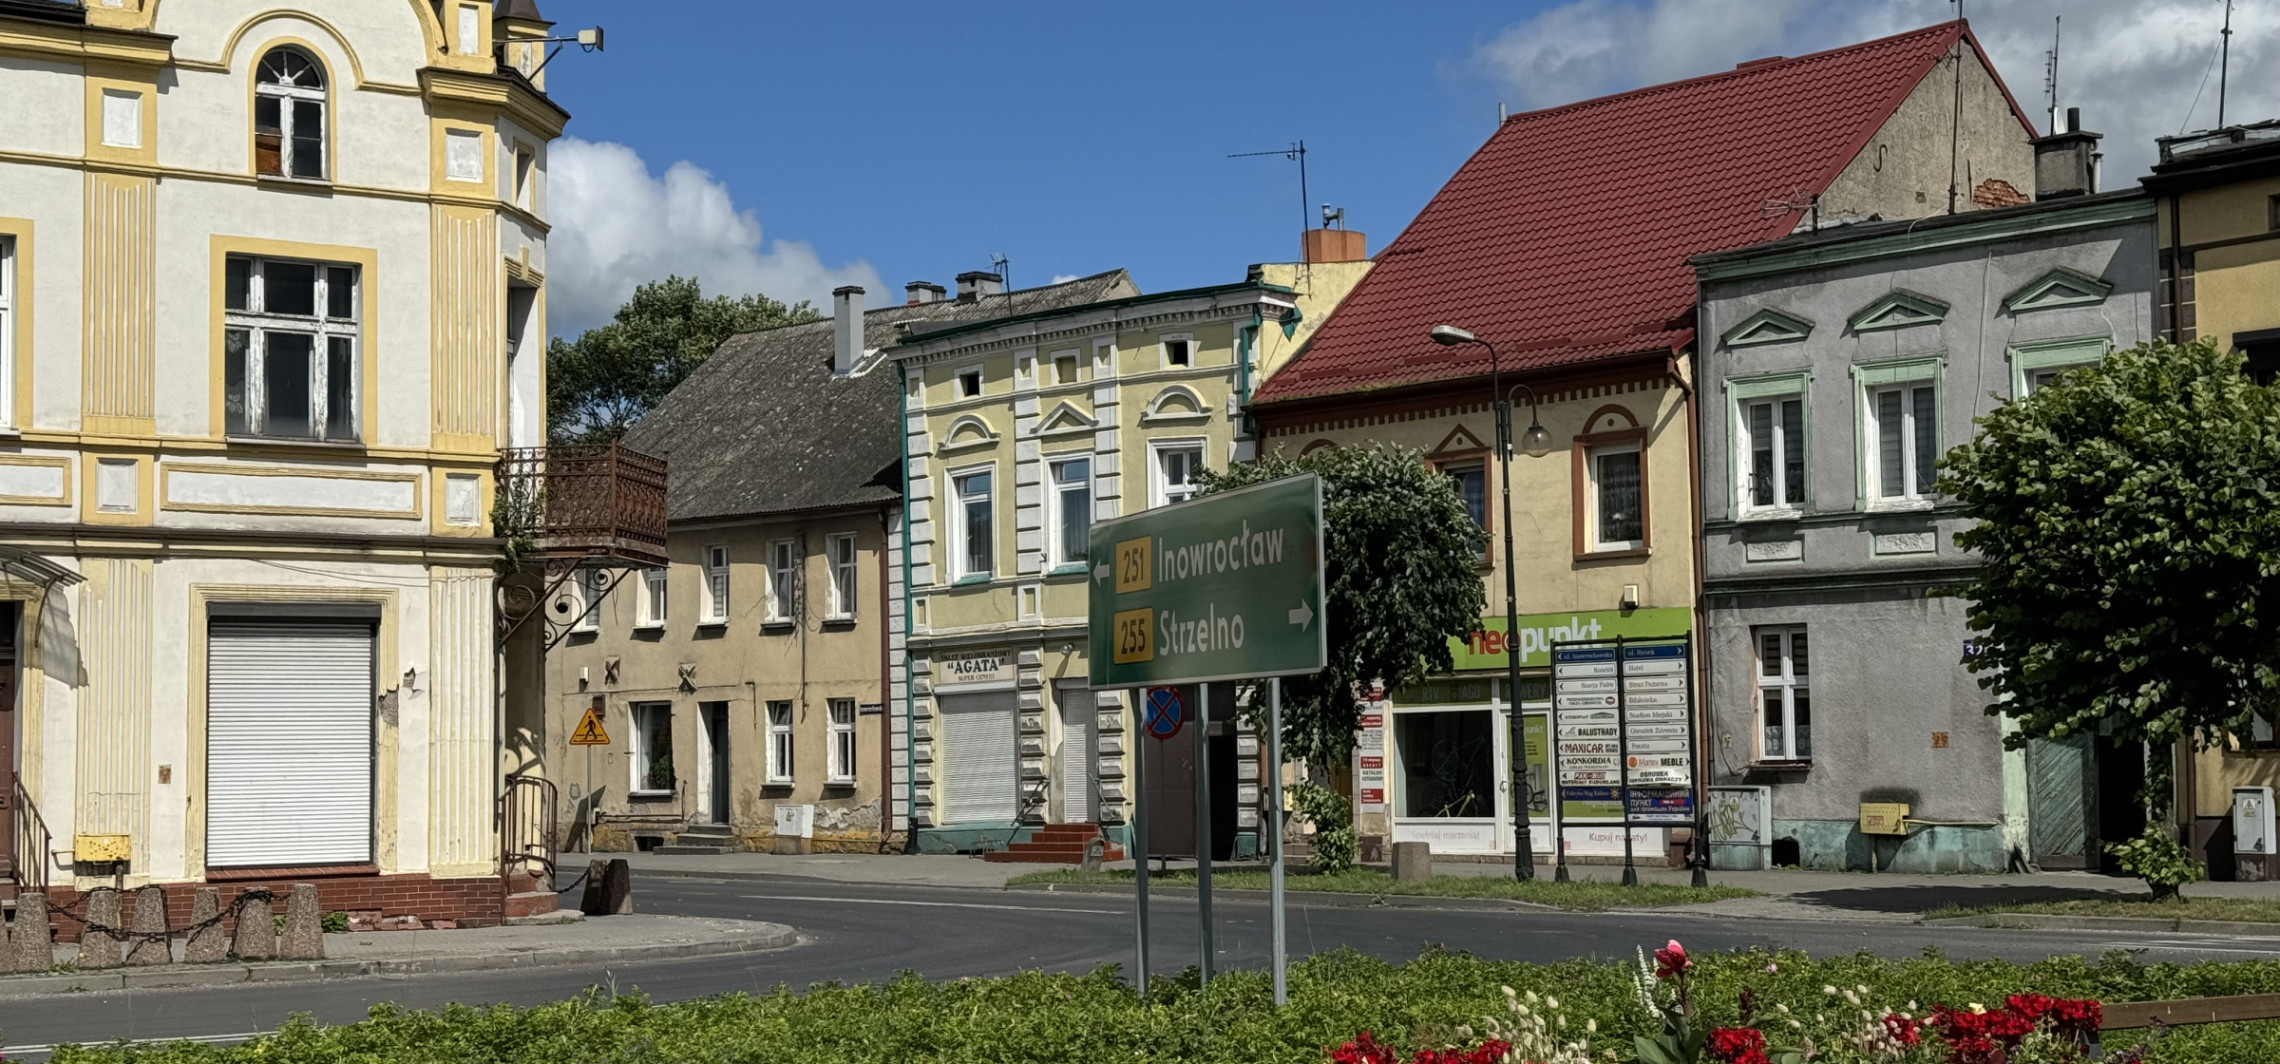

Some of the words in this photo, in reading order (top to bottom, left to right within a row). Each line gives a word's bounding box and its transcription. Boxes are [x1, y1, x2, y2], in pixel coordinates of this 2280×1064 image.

[1123, 547, 1145, 584] 251
[1158, 519, 1284, 582] Inowrocław
[1121, 618, 1146, 655] 255
[1159, 602, 1245, 657] Strzelno
[1505, 682, 1546, 699] RWERY
[1578, 727, 1618, 736] BALUSTRADY
[1565, 743, 1604, 753] MAXICAR
[1567, 757, 1611, 765] KONKORDIA
[1660, 757, 1684, 766] MEBLE
